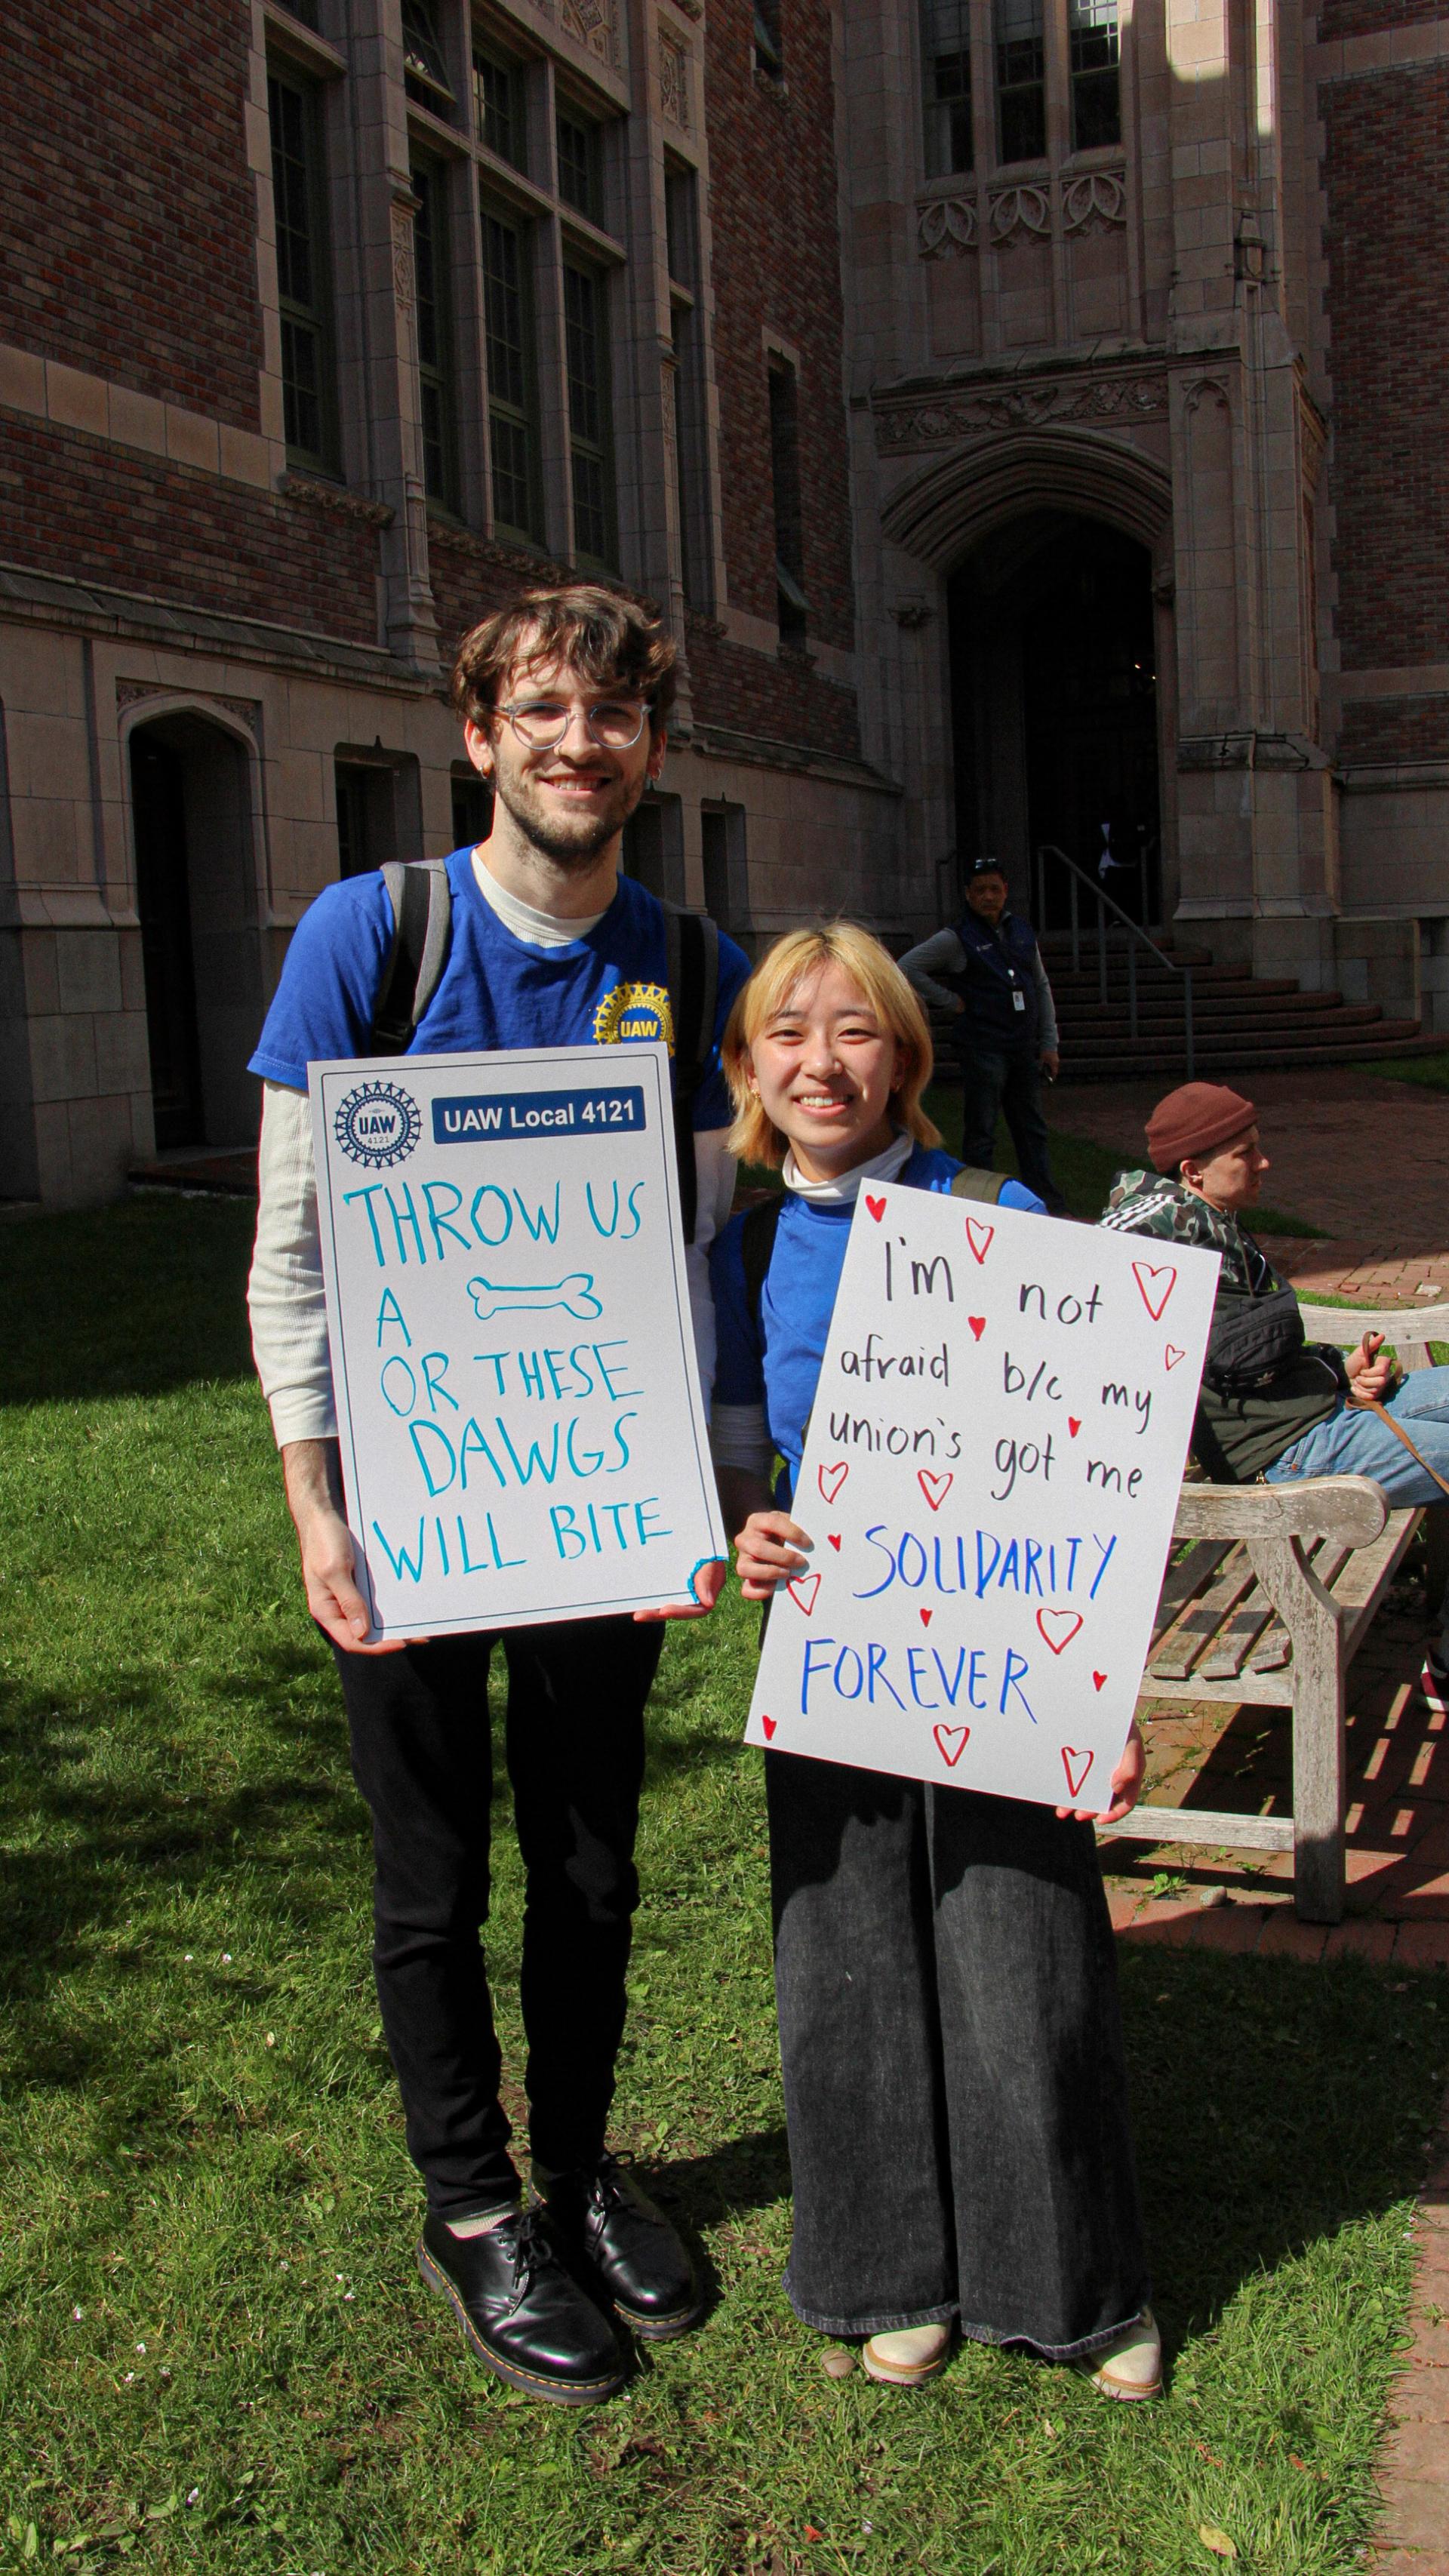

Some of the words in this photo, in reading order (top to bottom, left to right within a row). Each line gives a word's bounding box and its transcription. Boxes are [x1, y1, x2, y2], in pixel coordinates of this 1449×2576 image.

[621, 1020, 658, 1037] UAW
[358, 1116, 395, 1134] UAW
[445, 1108, 502, 1131] UAW
[511, 1103, 574, 1128] Local
[582, 1100, 633, 1122] 4121
[343, 1181, 559, 1266] THROW
[586, 1180, 644, 1239] US
[377, 1288, 411, 1346] A
[885, 1236, 954, 1303] I'm
[1020, 1285, 1102, 1324] not
[381, 1352, 458, 1416] OR
[474, 1341, 644, 1402] THESE
[841, 1334, 948, 1386] afraid
[1005, 1352, 1061, 1401] b/c
[1103, 1383, 1151, 1434] my
[409, 1413, 636, 1497] DAWGS
[830, 1413, 960, 1458] union's
[991, 1434, 1054, 1500] got
[1088, 1461, 1142, 1497] me
[373, 1513, 525, 1582] WILL
[549, 1497, 673, 1559] BITE
[853, 1525, 1118, 1599] SOLIDARITY
[801, 1639, 1035, 1722] FOREVER
